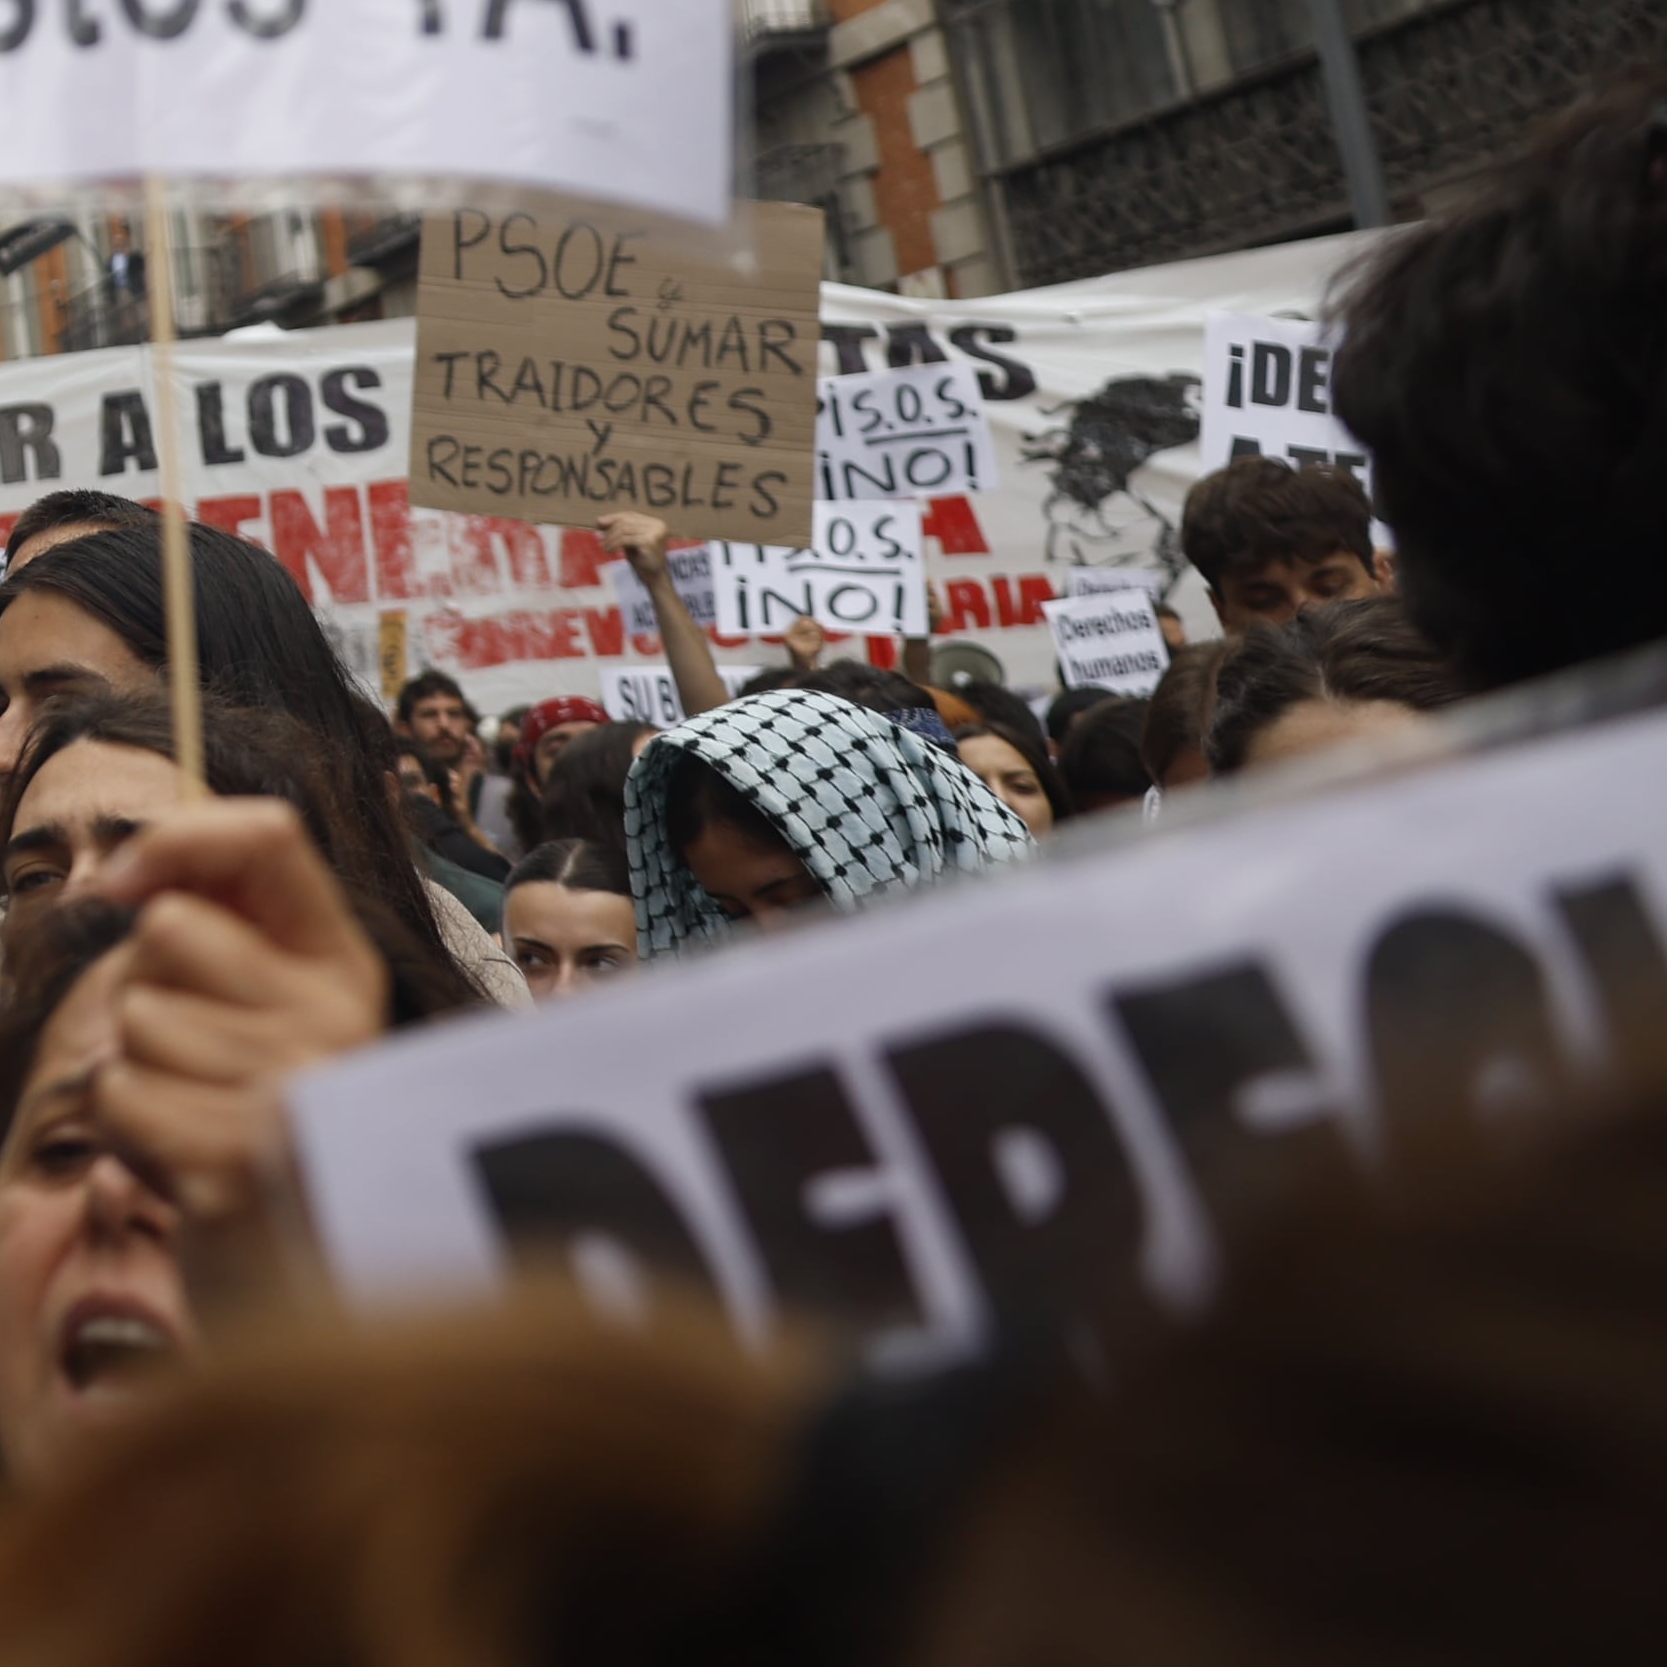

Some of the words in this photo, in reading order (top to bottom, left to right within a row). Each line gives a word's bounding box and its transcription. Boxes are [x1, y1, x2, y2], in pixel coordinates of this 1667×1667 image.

[452, 208, 637, 300] PSOE
[607, 306, 803, 375] SUMAR
[1226, 339, 1330, 414] ¡DE
[196, 365, 391, 467] LOS
[431, 350, 772, 446] TRAIDORES
[427, 434, 788, 520] RESPONSABLES
[619, 674, 678, 723] SUB
[1070, 649, 1160, 682] humanos
